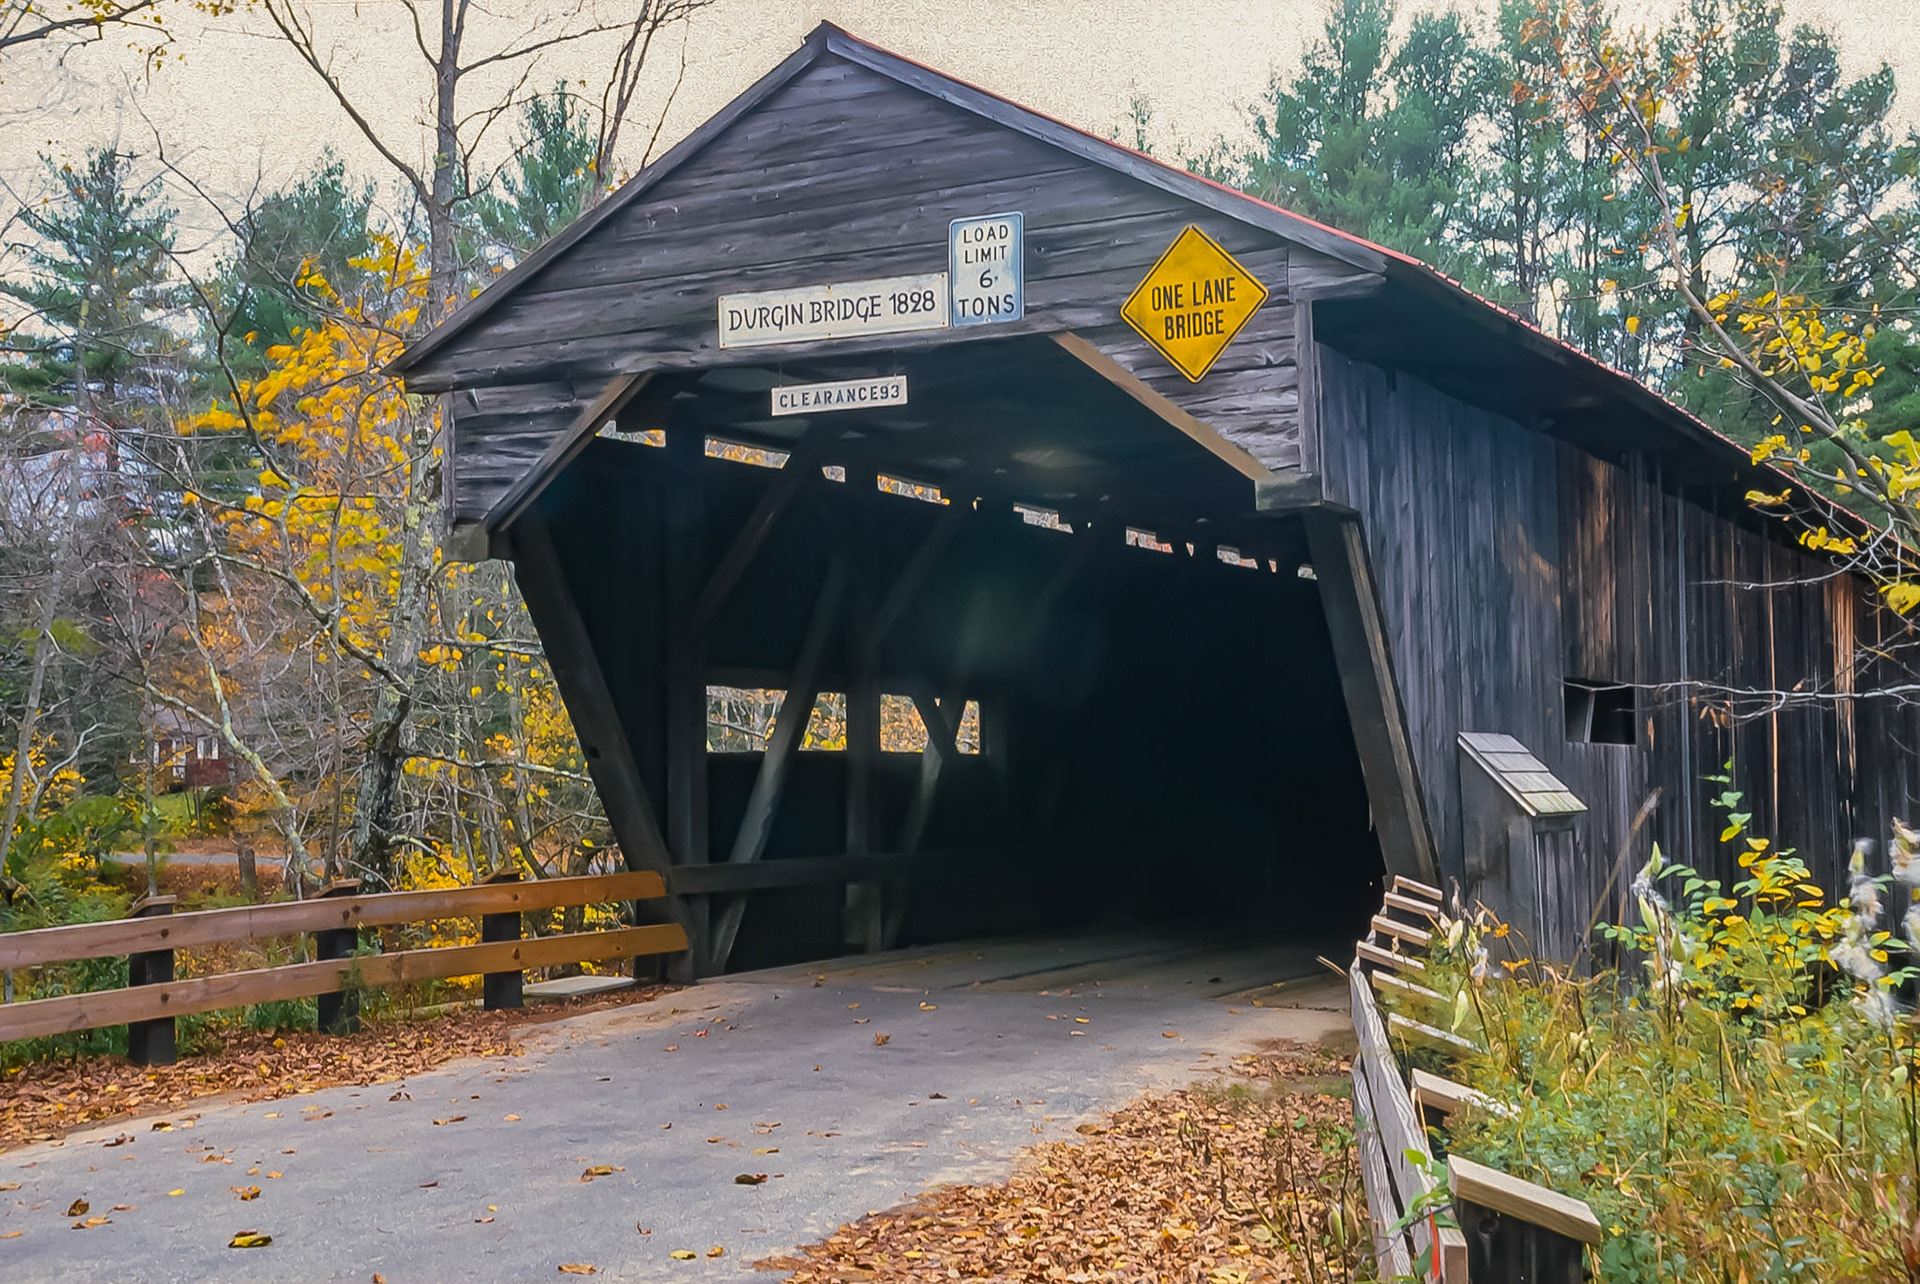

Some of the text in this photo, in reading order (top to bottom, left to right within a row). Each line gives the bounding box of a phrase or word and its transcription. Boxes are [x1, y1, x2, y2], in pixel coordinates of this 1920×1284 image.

[963, 225, 1008, 243] LOAD
[965, 245, 1007, 264] LIMIT
[958, 294, 1015, 317] TONS
[1151, 277, 1236, 312] ONE LANE
[728, 290, 936, 331] DURGIN BRIDGE 1828
[1164, 310, 1225, 340] BRIDGE
